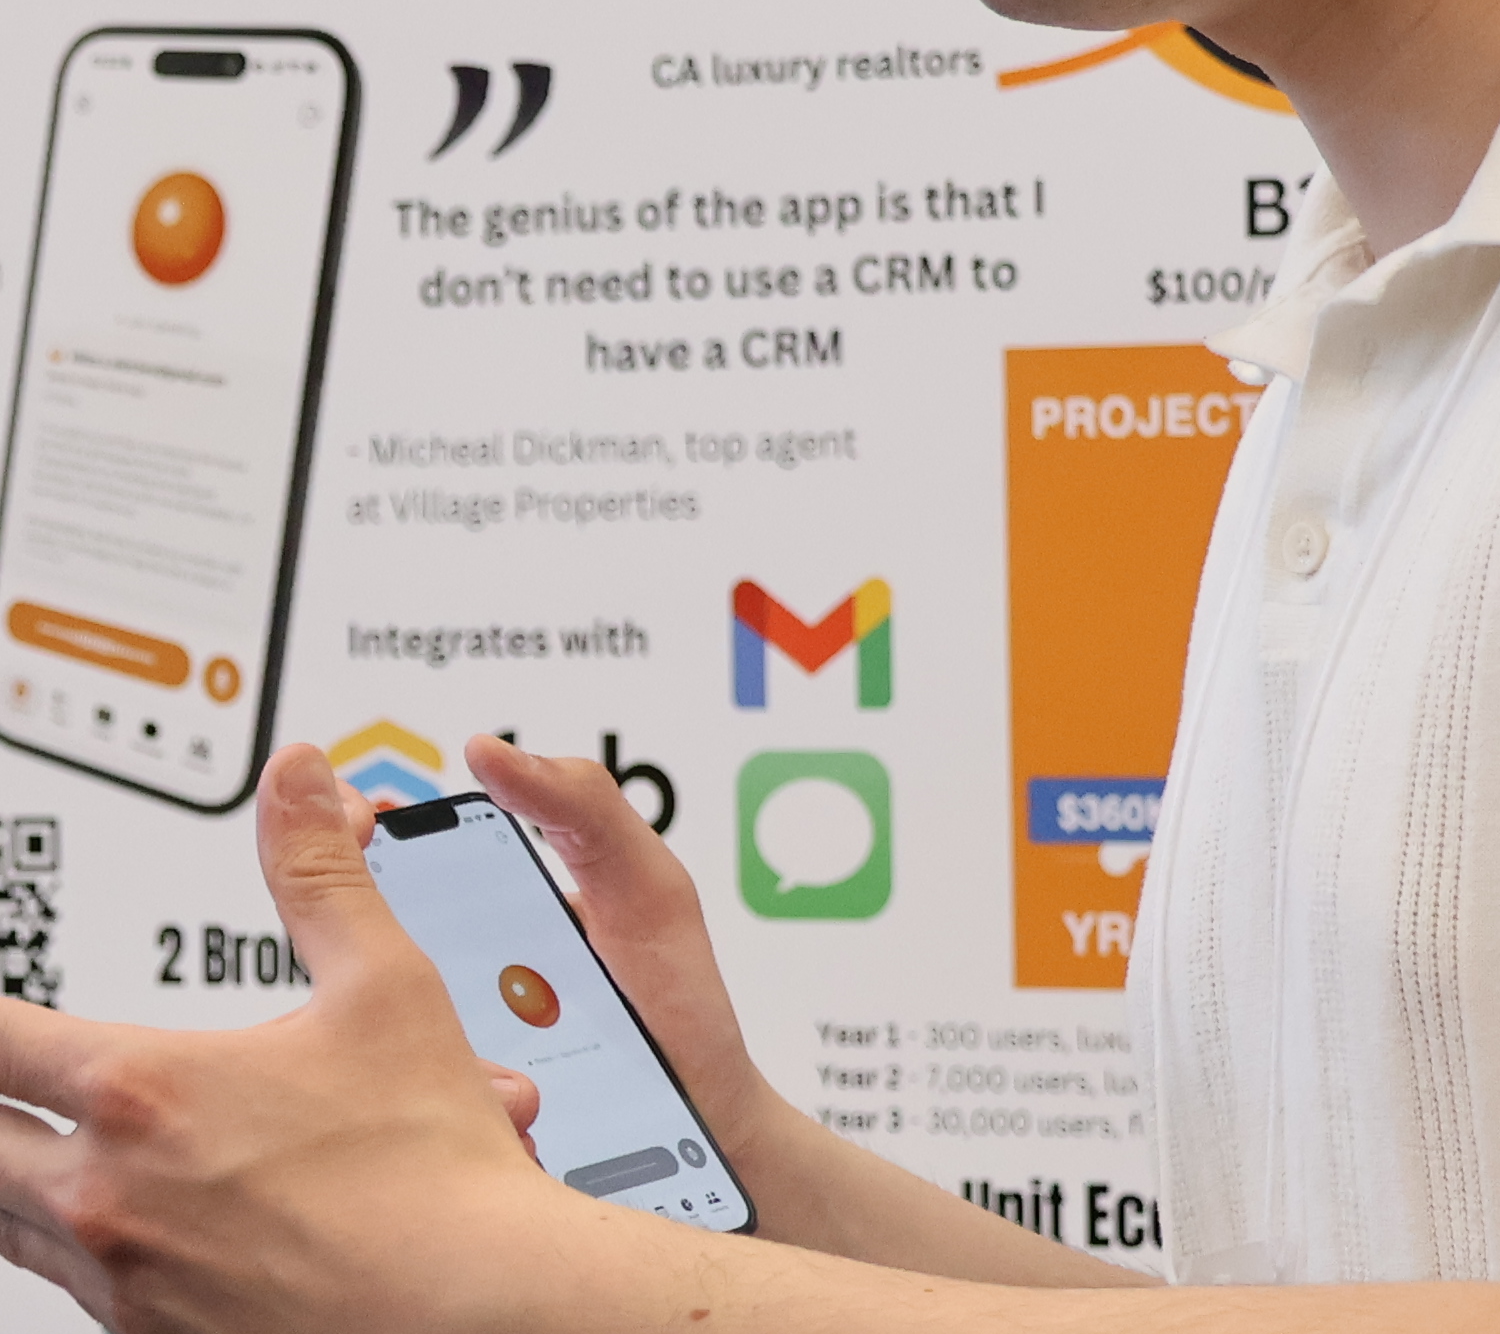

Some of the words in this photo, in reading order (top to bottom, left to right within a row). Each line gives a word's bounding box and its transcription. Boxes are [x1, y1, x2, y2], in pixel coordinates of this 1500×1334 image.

[652, 54, 700, 88] CA
[709, 49, 828, 96] luxury
[838, 43, 981, 82] realtors
[394, 199, 473, 241] The
[484, 194, 622, 246] genius
[634, 189, 683, 232] of
[692, 191, 765, 232] the
[778, 187, 862, 236] app
[877, 183, 913, 225] is
[925, 179, 1020, 222] that
[1033, 177, 1047, 219] I
[419, 265, 536, 310] don't
[546, 263, 653, 305] need
[666, 261, 712, 304] to
[723, 263, 802, 300] use
[812, 261, 841, 297] a
[852, 254, 956, 296] CRM
[970, 252, 1017, 293] to
[584, 330, 692, 374] have
[702, 335, 728, 369] a
[740, 329, 843, 371] CRM
[369, 429, 505, 466] Micheal
[512, 427, 675, 466] Dickman,
[683, 427, 747, 466] top
[755, 425, 858, 465] agent
[345, 489, 381, 524] at
[388, 488, 505, 527] Village
[512, 485, 700, 527] Properties
[347, 622, 552, 664] Integrates
[558, 619, 648, 658] with
[158, 927, 182, 982] 2
[815, 1022, 878, 1047] Year
[886, 1022, 899, 1047] 1
[925, 1021, 983, 1052] 300
[986, 1024, 1072, 1053] users,
[815, 1065, 878, 1089] Year
[886, 1065, 899, 1091] 2
[1013, 1068, 1097, 1096] users,
[815, 1107, 878, 1132] Year
[886, 1107, 901, 1134] 3
[926, 1107, 1033, 1138] 30,000
[1038, 1110, 1122, 1139] users,
[1086, 1181, 1163, 1251] Ec
